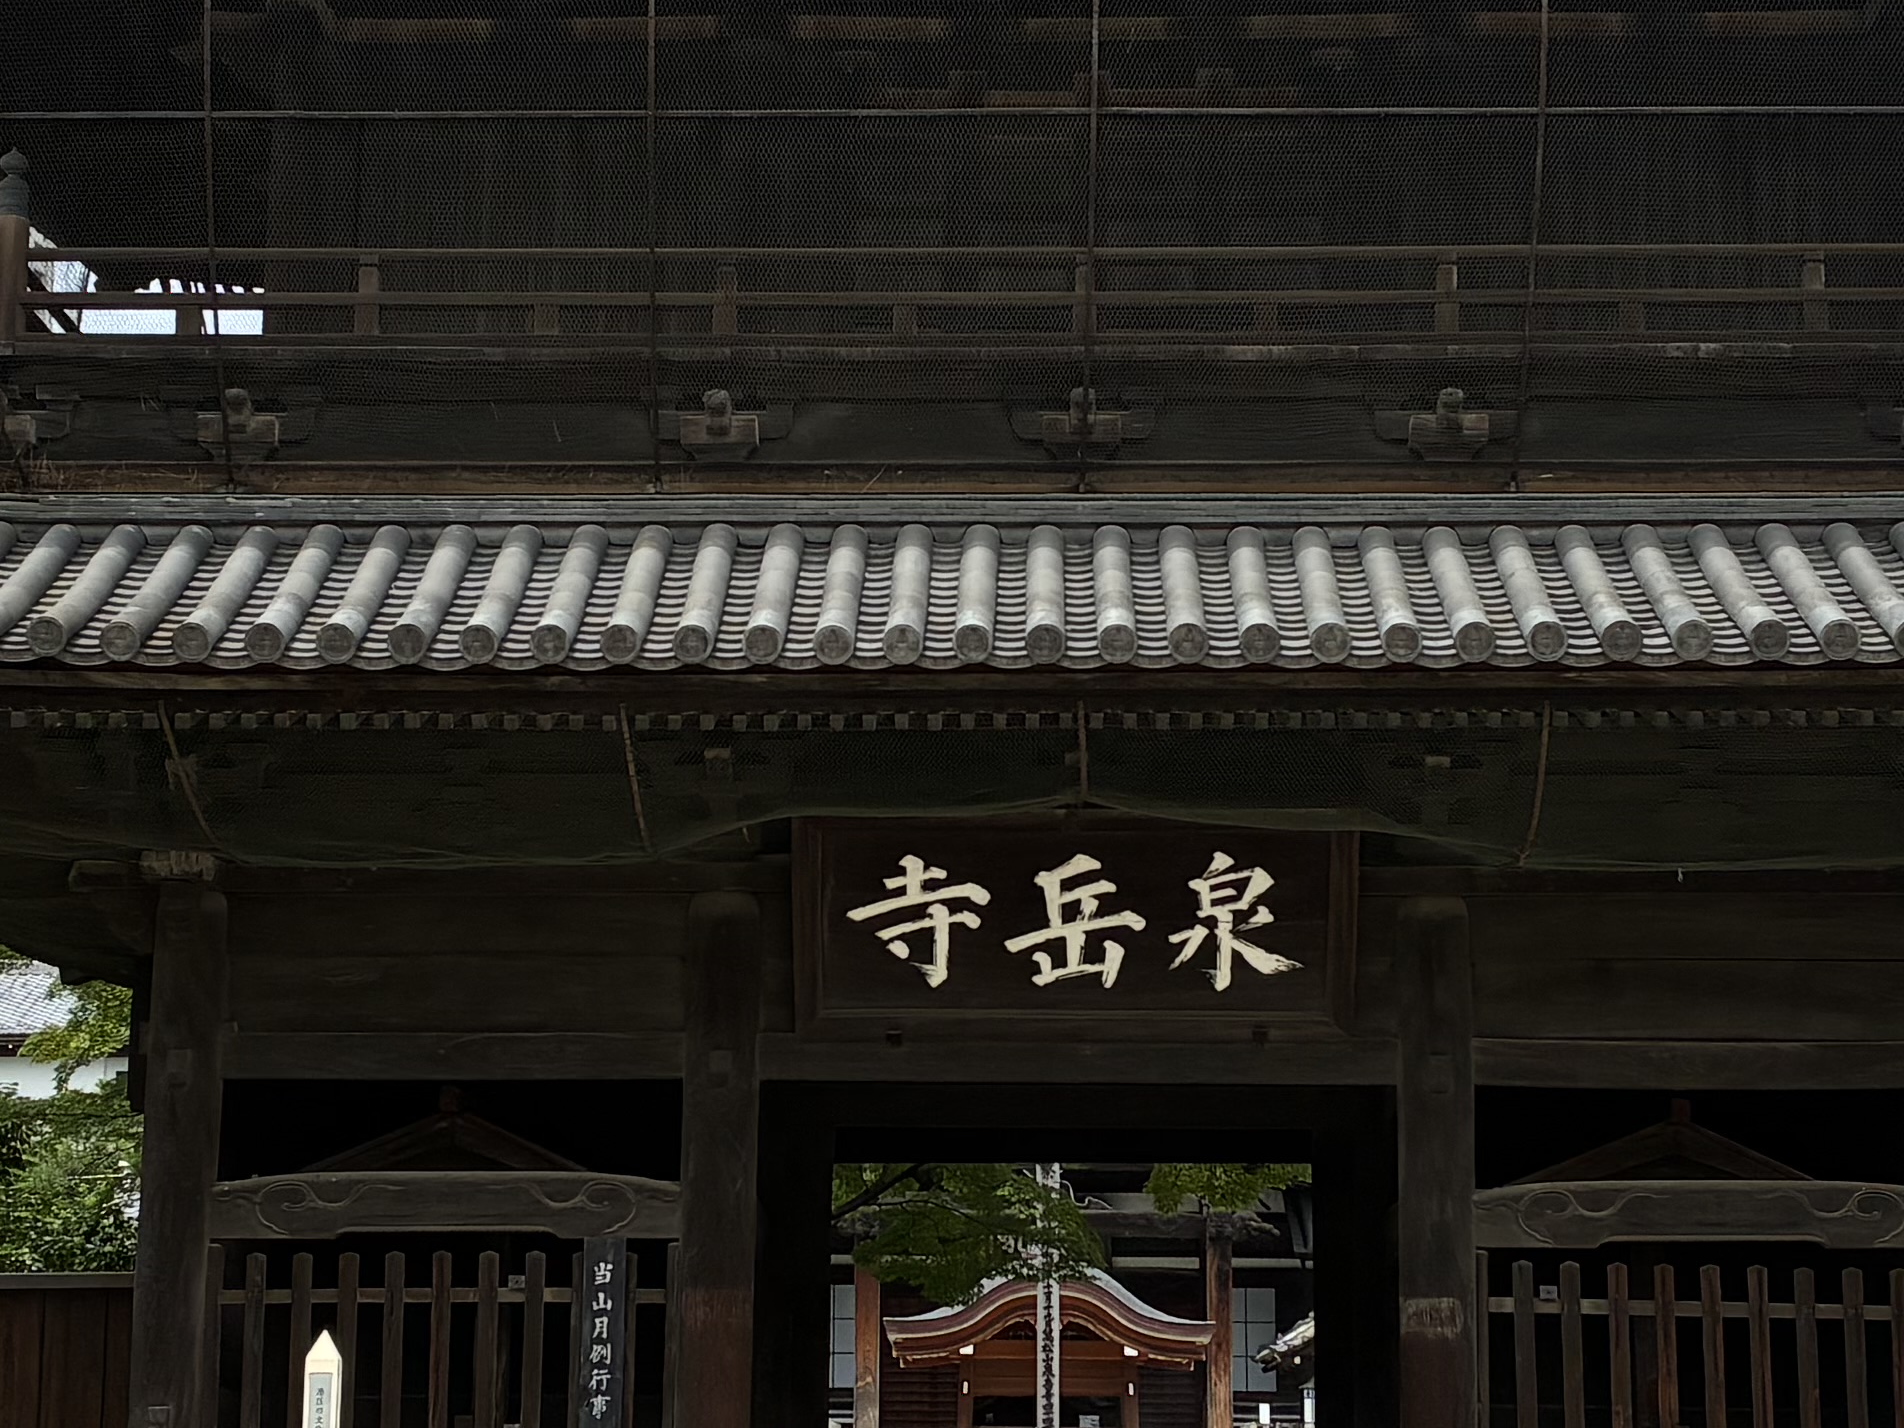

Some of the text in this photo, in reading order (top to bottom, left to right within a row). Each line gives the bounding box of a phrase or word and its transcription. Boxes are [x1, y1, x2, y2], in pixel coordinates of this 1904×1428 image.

[846, 851, 1306, 993] 泉岳寺
[588, 1261, 614, 1420] 当山月例行事
